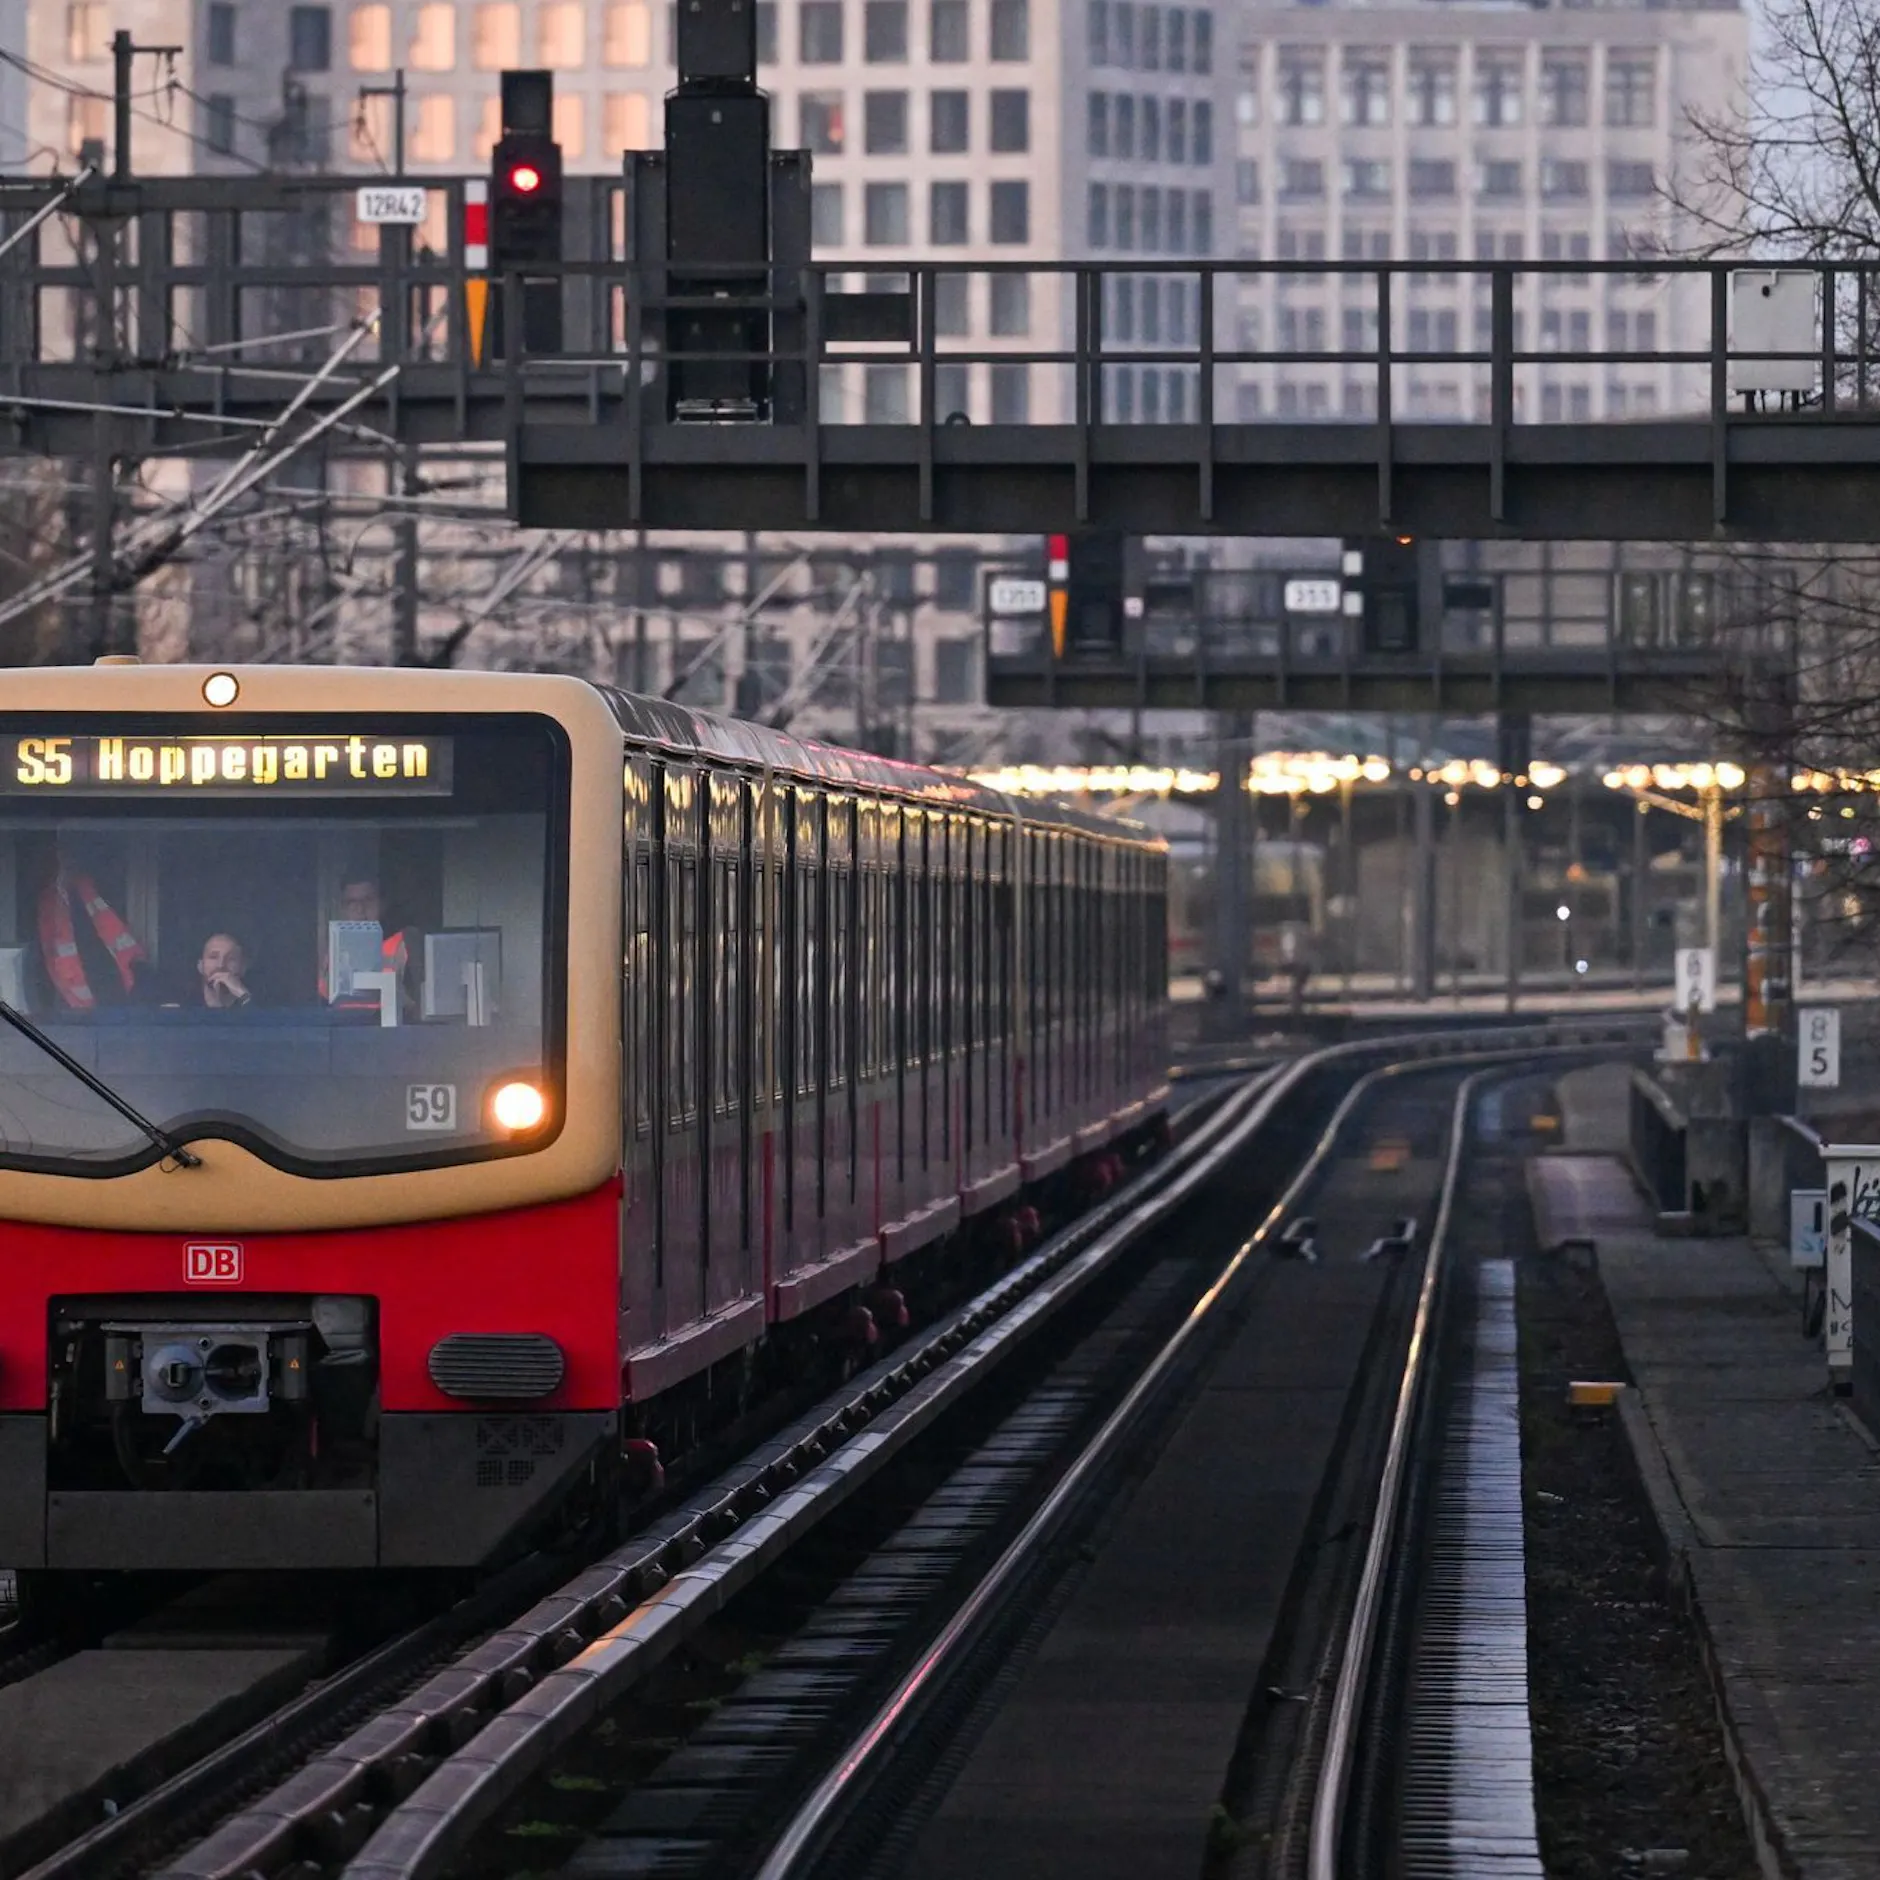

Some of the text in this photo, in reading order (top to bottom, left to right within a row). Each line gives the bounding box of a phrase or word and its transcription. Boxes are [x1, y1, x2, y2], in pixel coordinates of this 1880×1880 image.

[17, 735, 428, 784] S5 Hoppegarten
[1811, 1015, 1828, 1042] 8
[1810, 1047, 1828, 1076] 5
[409, 1085, 450, 1124] 59
[190, 1248, 237, 1278] DB
